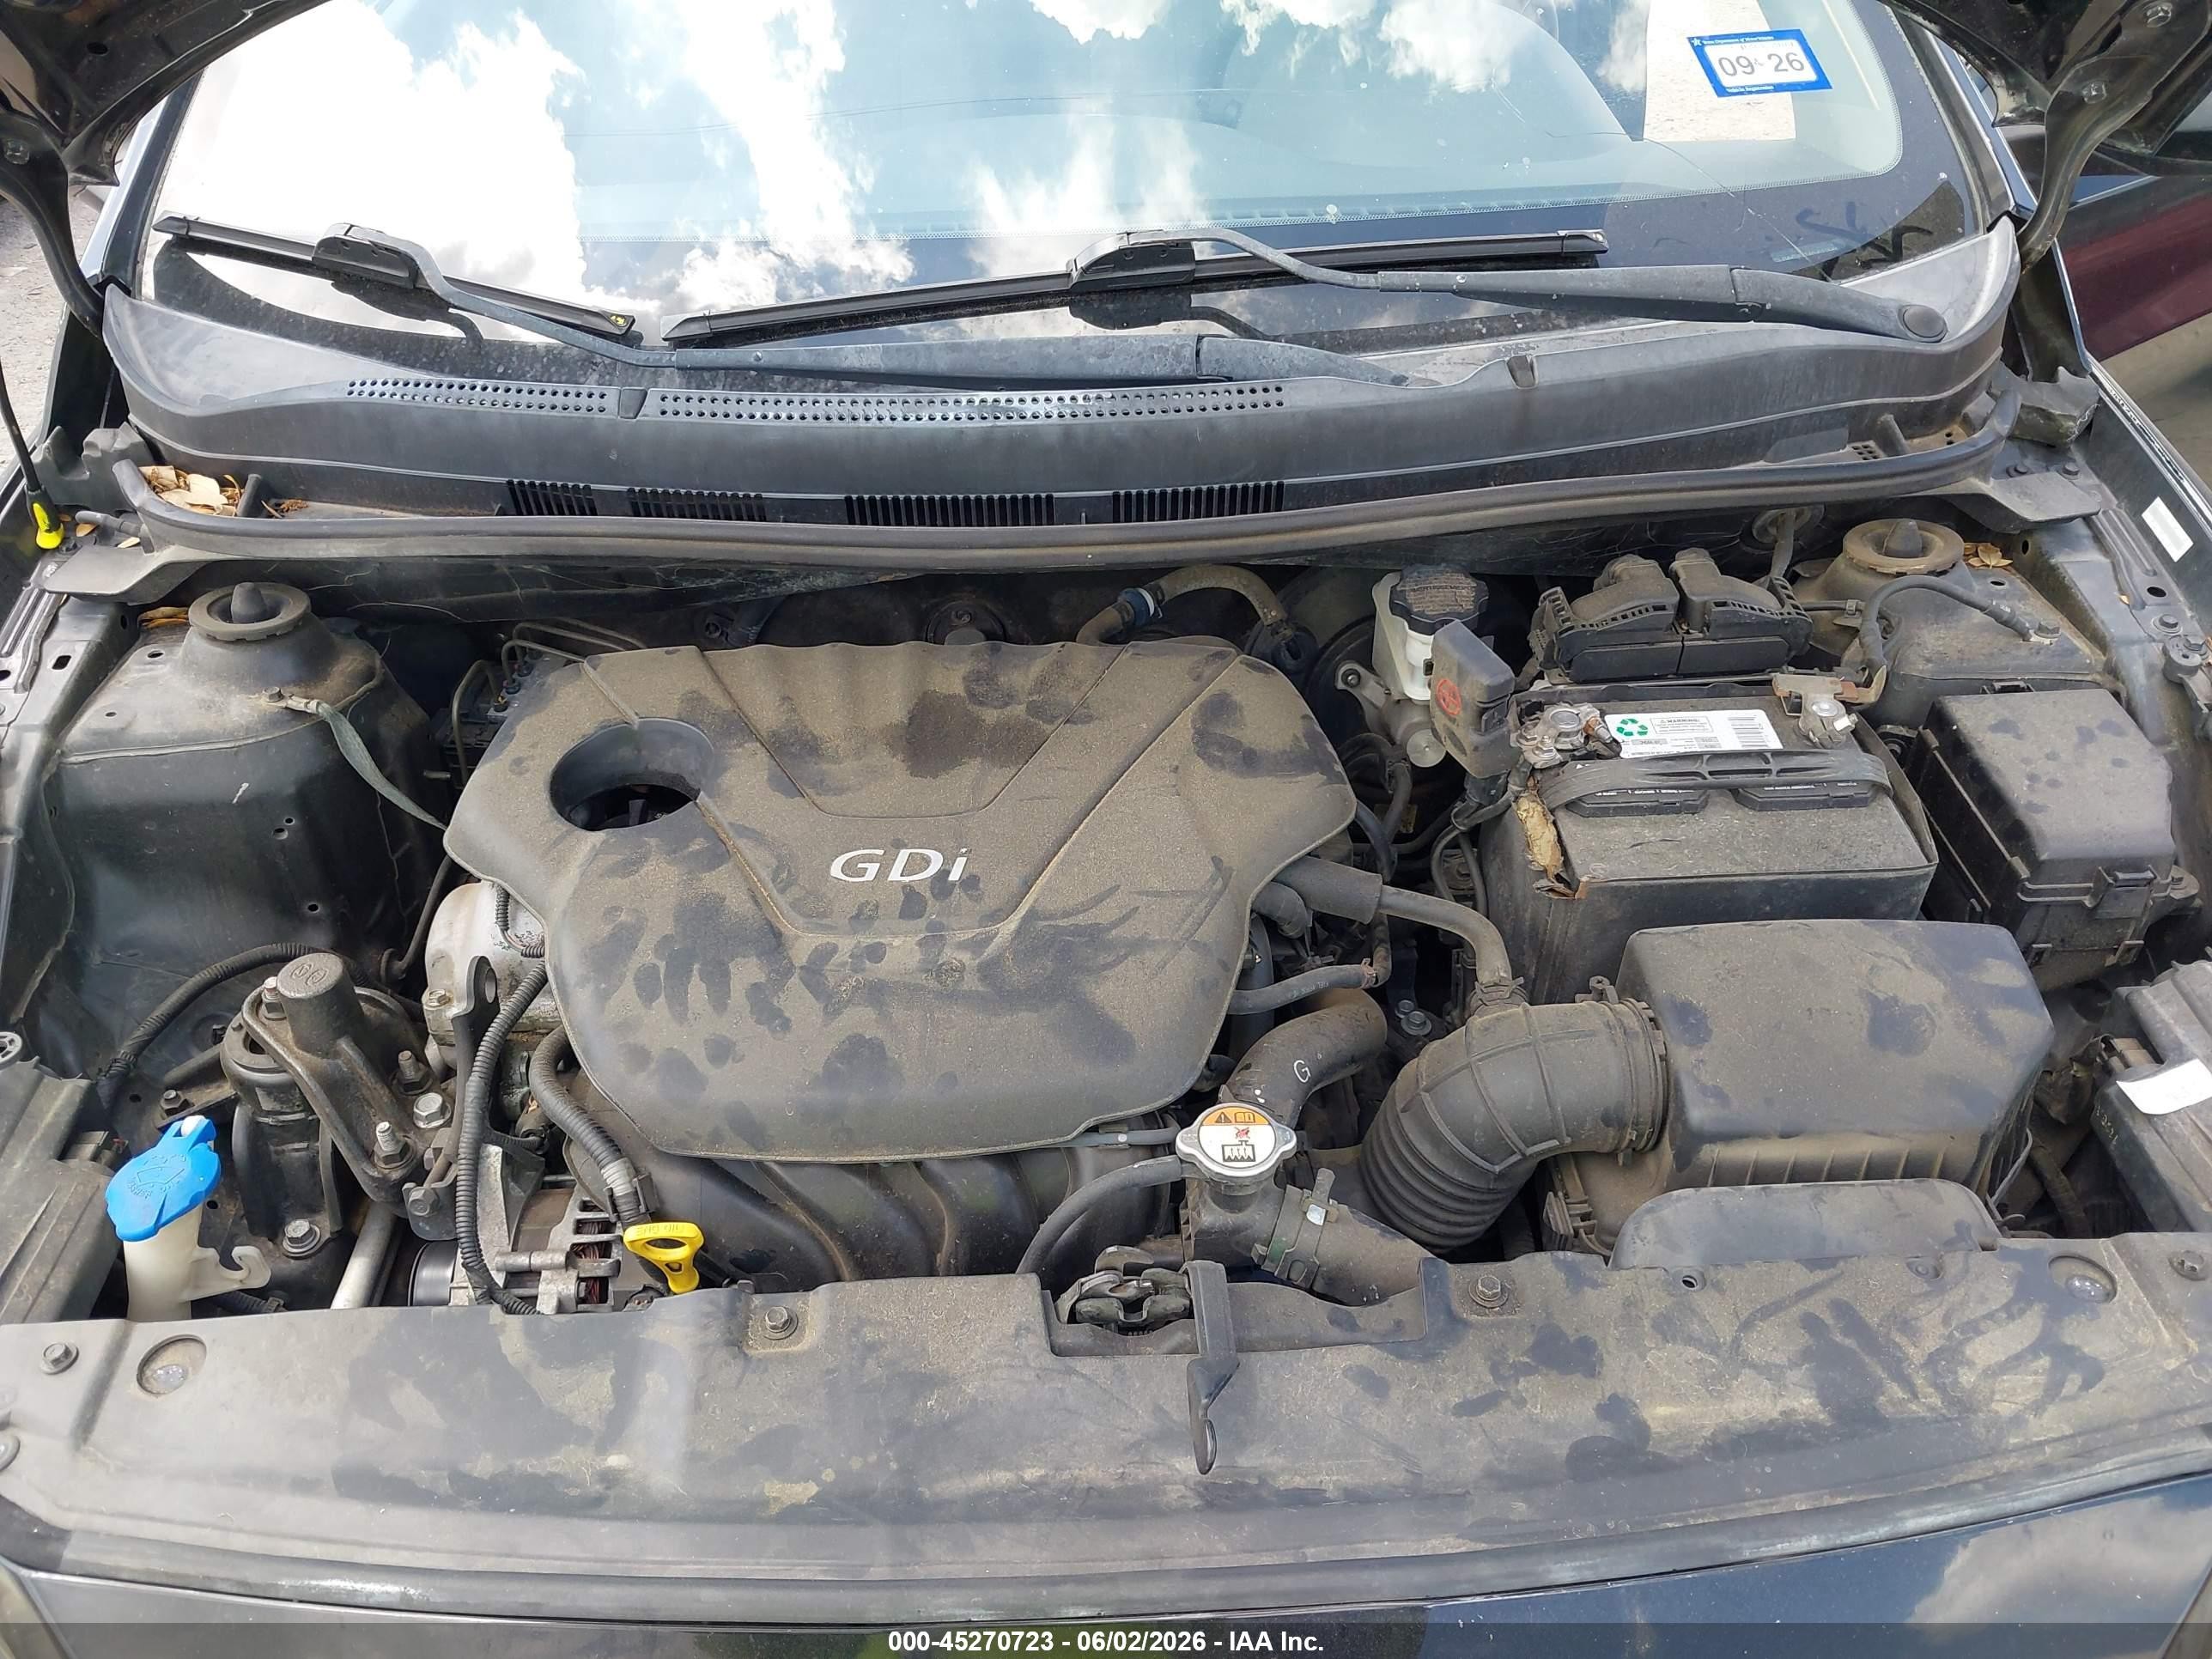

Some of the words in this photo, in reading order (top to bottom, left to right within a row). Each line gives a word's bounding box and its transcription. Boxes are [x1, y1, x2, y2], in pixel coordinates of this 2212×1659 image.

[1717, 56, 1755, 76] 09
[1767, 52, 1805, 72] 26
[830, 848, 969, 882] GDi
[1293, 1060, 1311, 1083] G
